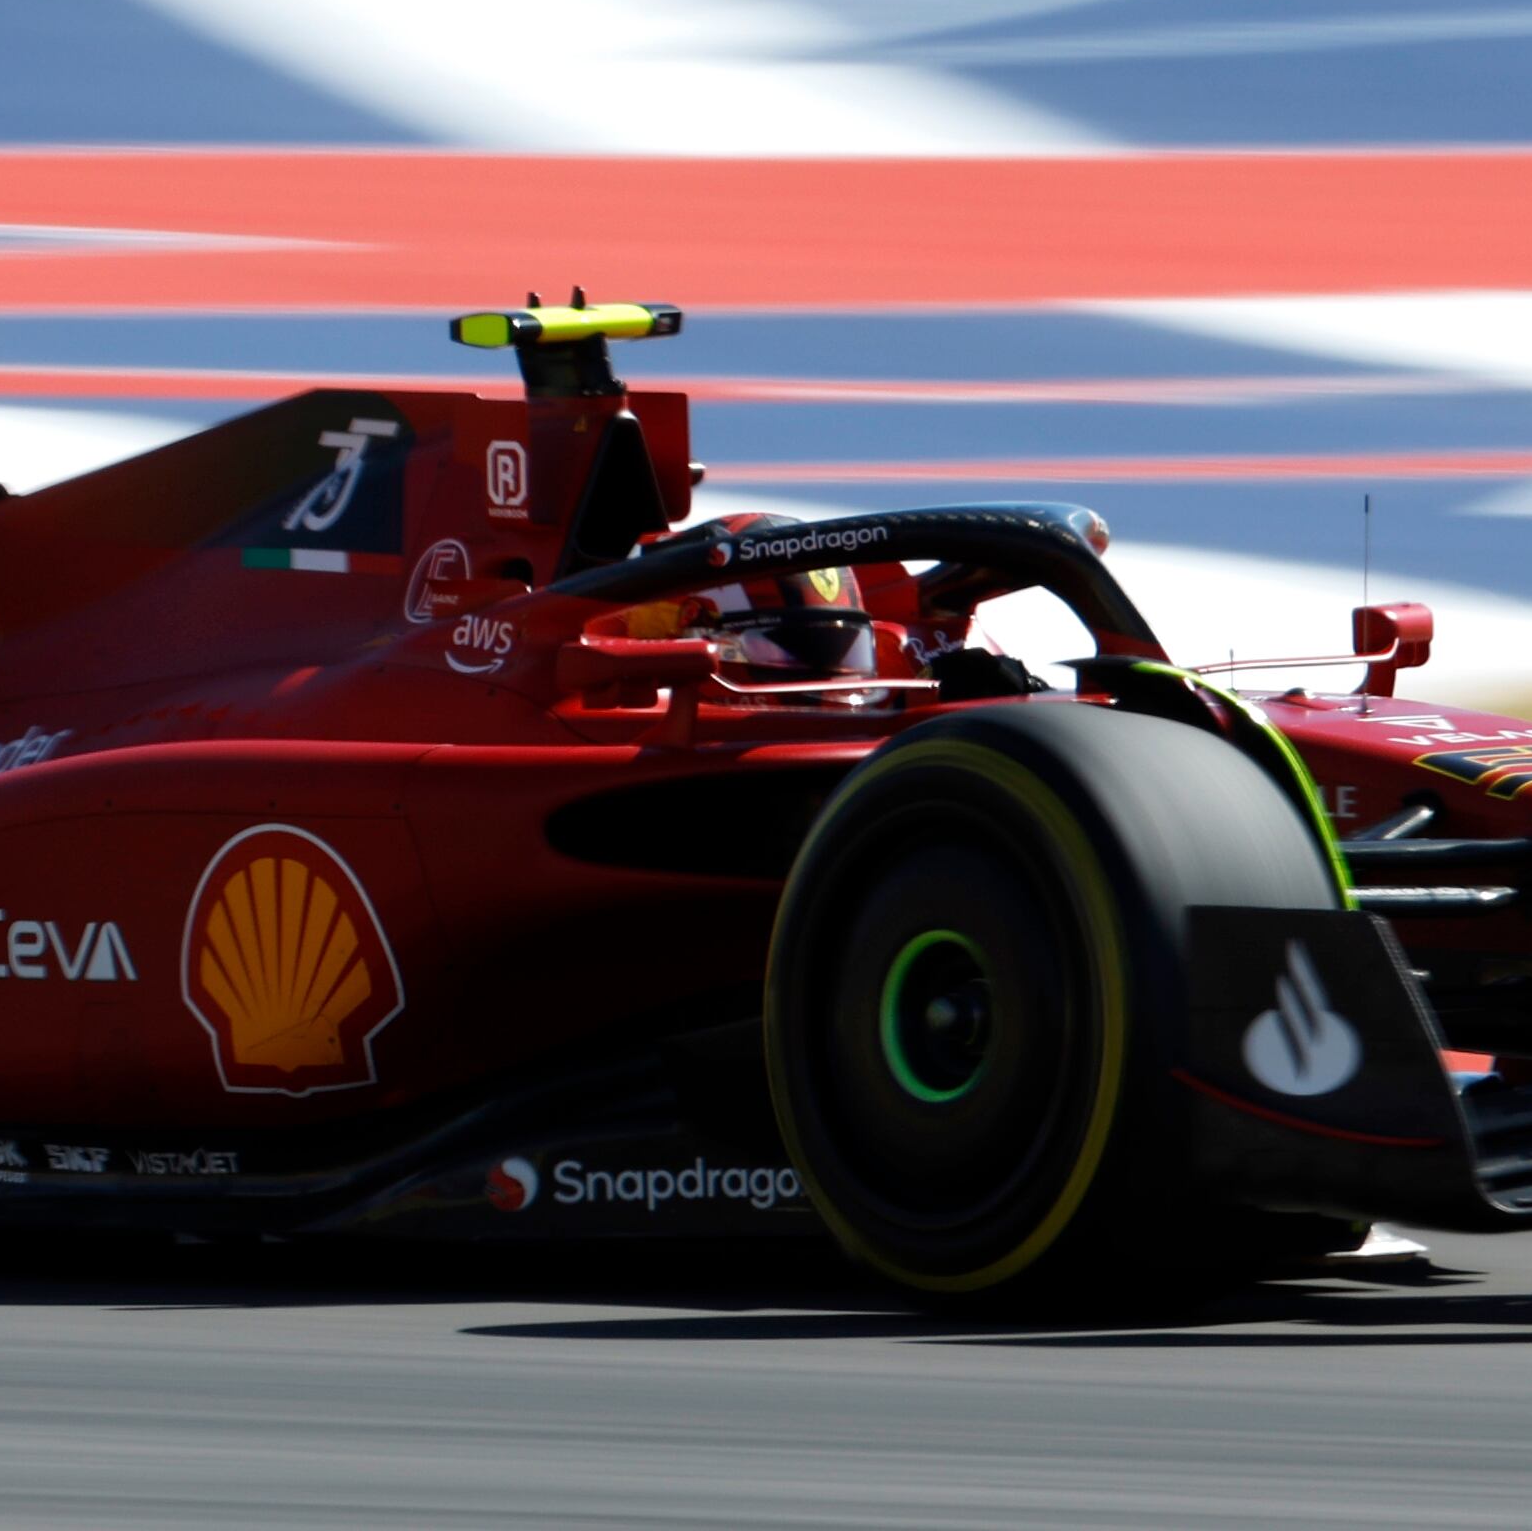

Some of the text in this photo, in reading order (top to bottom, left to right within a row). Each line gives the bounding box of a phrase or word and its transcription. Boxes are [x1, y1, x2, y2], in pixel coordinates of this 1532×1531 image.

[738, 525, 888, 560] Snapdragon
[453, 614, 514, 655] aws
[553, 1156, 801, 1209] Snapdrago
